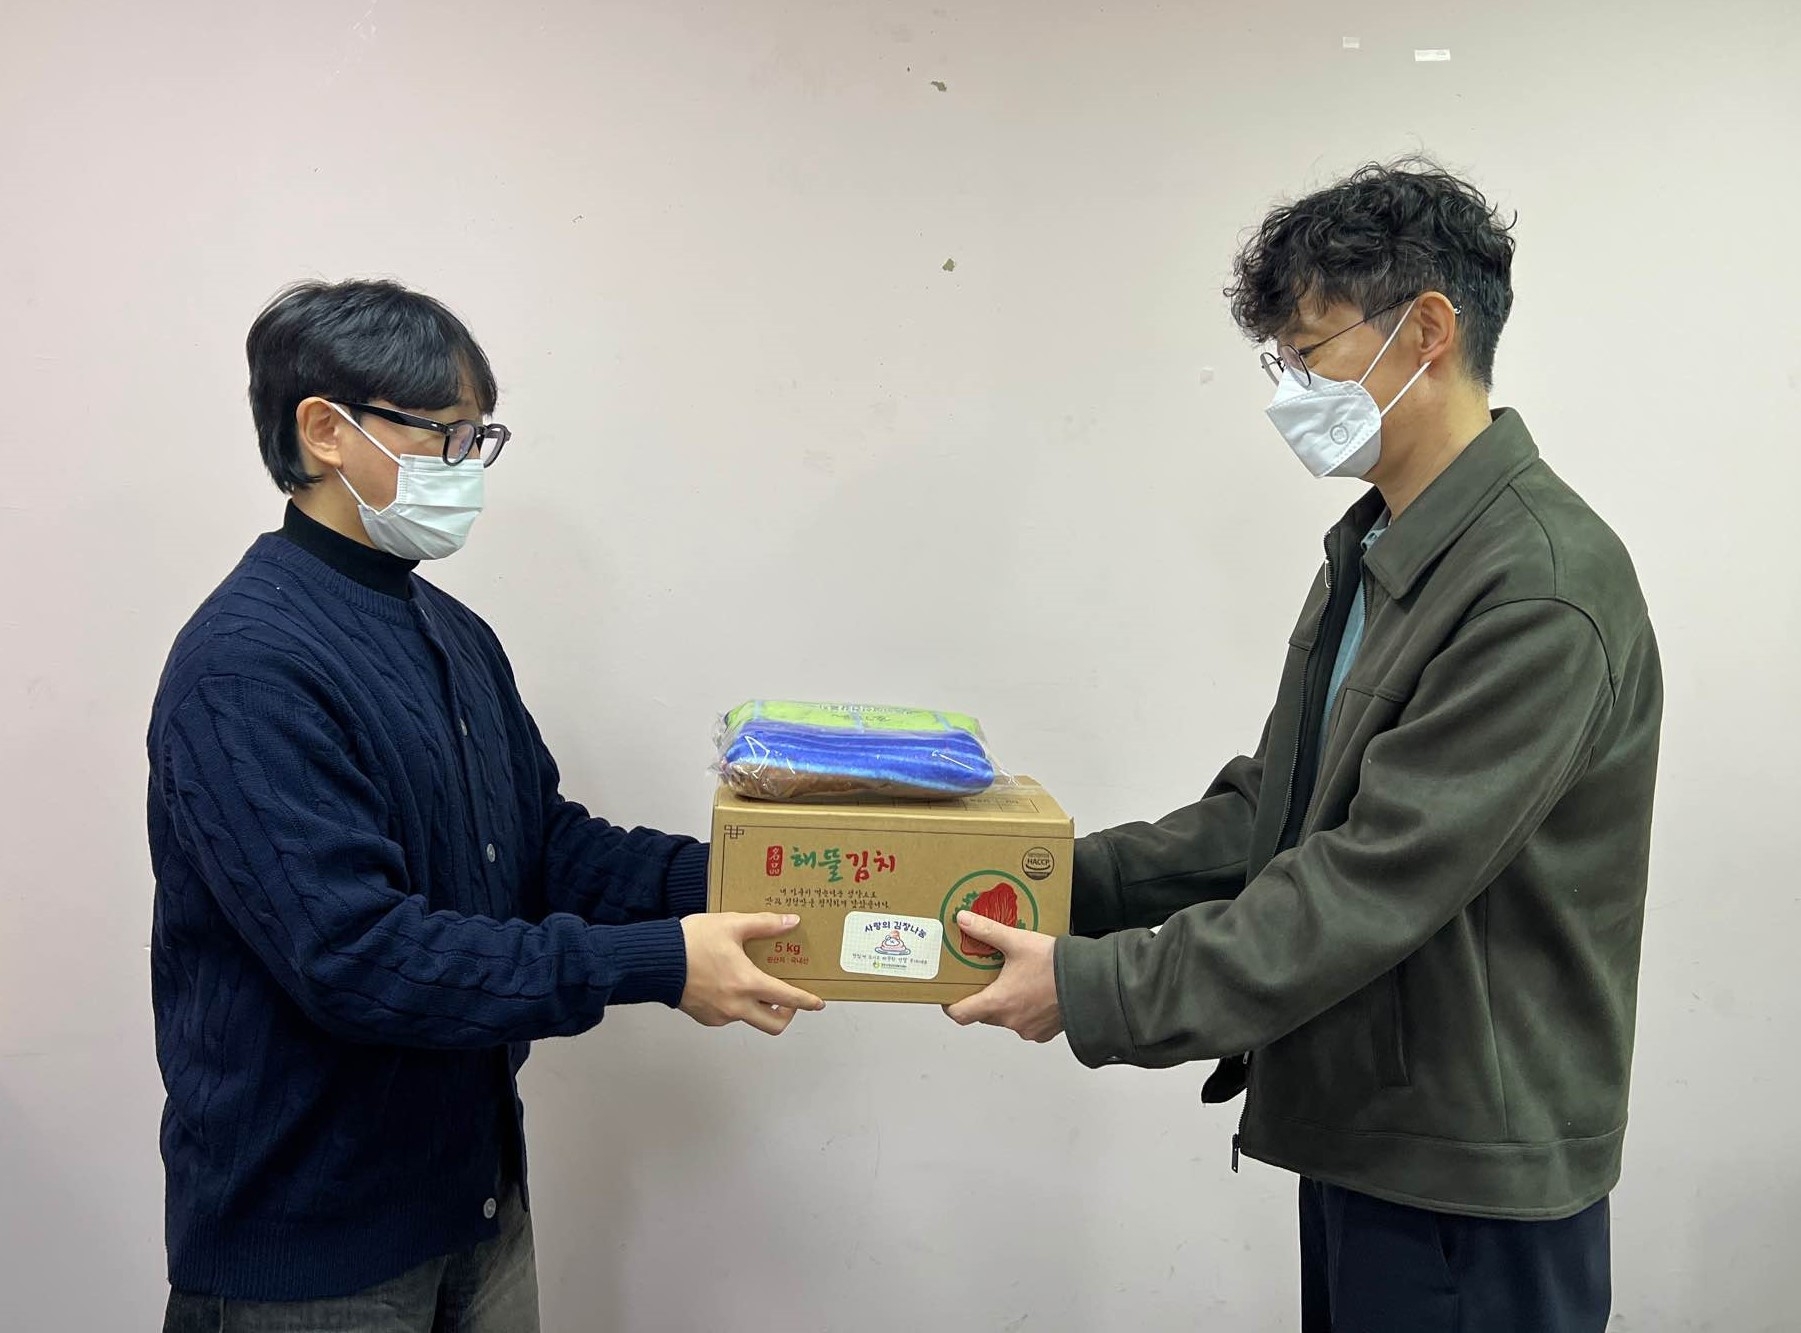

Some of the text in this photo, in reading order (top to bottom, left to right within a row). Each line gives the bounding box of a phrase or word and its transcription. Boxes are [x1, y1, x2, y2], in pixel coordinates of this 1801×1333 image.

[865, 921, 927, 939] 사랑의 김장나눔
[775, 942, 801, 955] 5 kg
